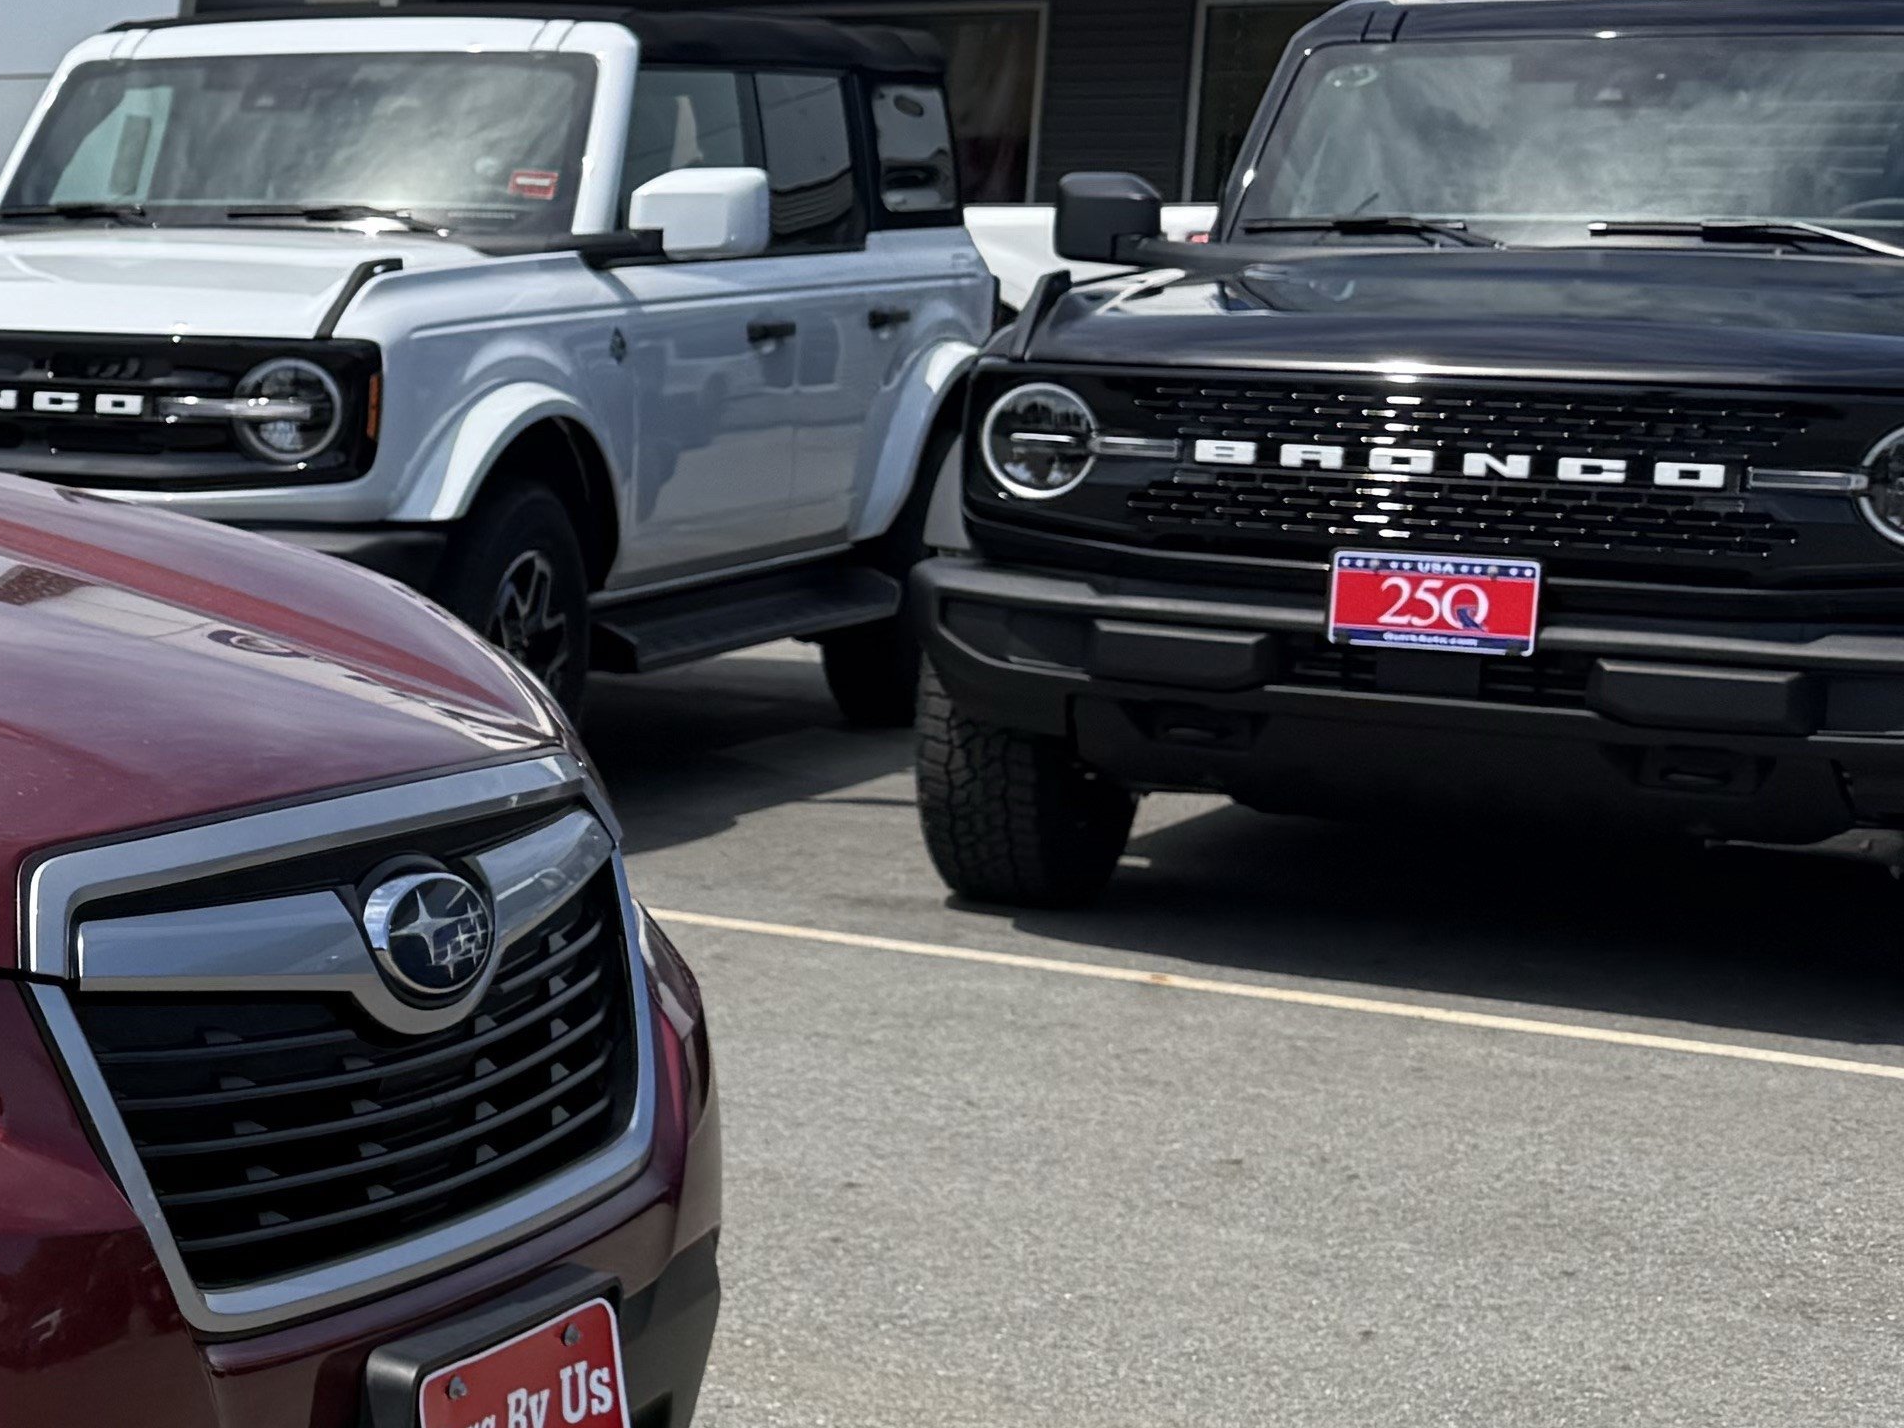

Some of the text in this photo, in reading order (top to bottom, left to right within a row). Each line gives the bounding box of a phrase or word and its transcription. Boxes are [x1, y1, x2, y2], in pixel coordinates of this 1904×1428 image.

[1194, 438, 1726, 490] BRONCO
[1417, 561, 1455, 575] USA
[559, 1359, 614, 1424] Us
